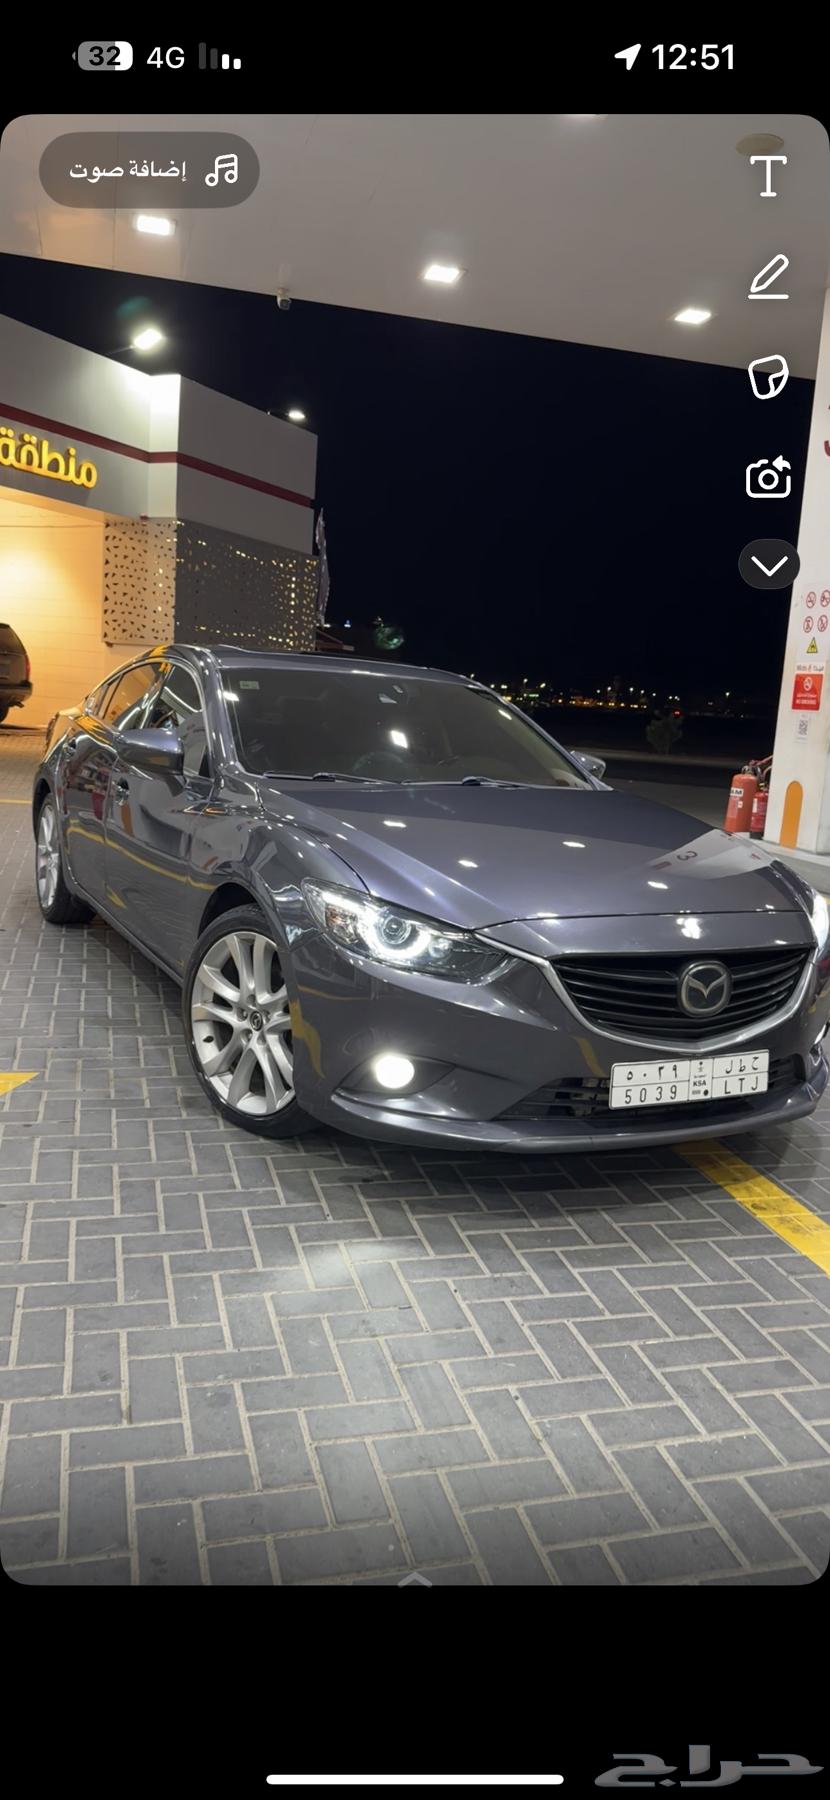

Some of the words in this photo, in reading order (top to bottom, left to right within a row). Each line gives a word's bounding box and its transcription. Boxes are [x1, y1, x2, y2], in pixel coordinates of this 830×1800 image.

[0, 426, 97, 489] منطقة
[624, 1084, 677, 1105] 5039
[724, 1076, 759, 1095] LTJ
